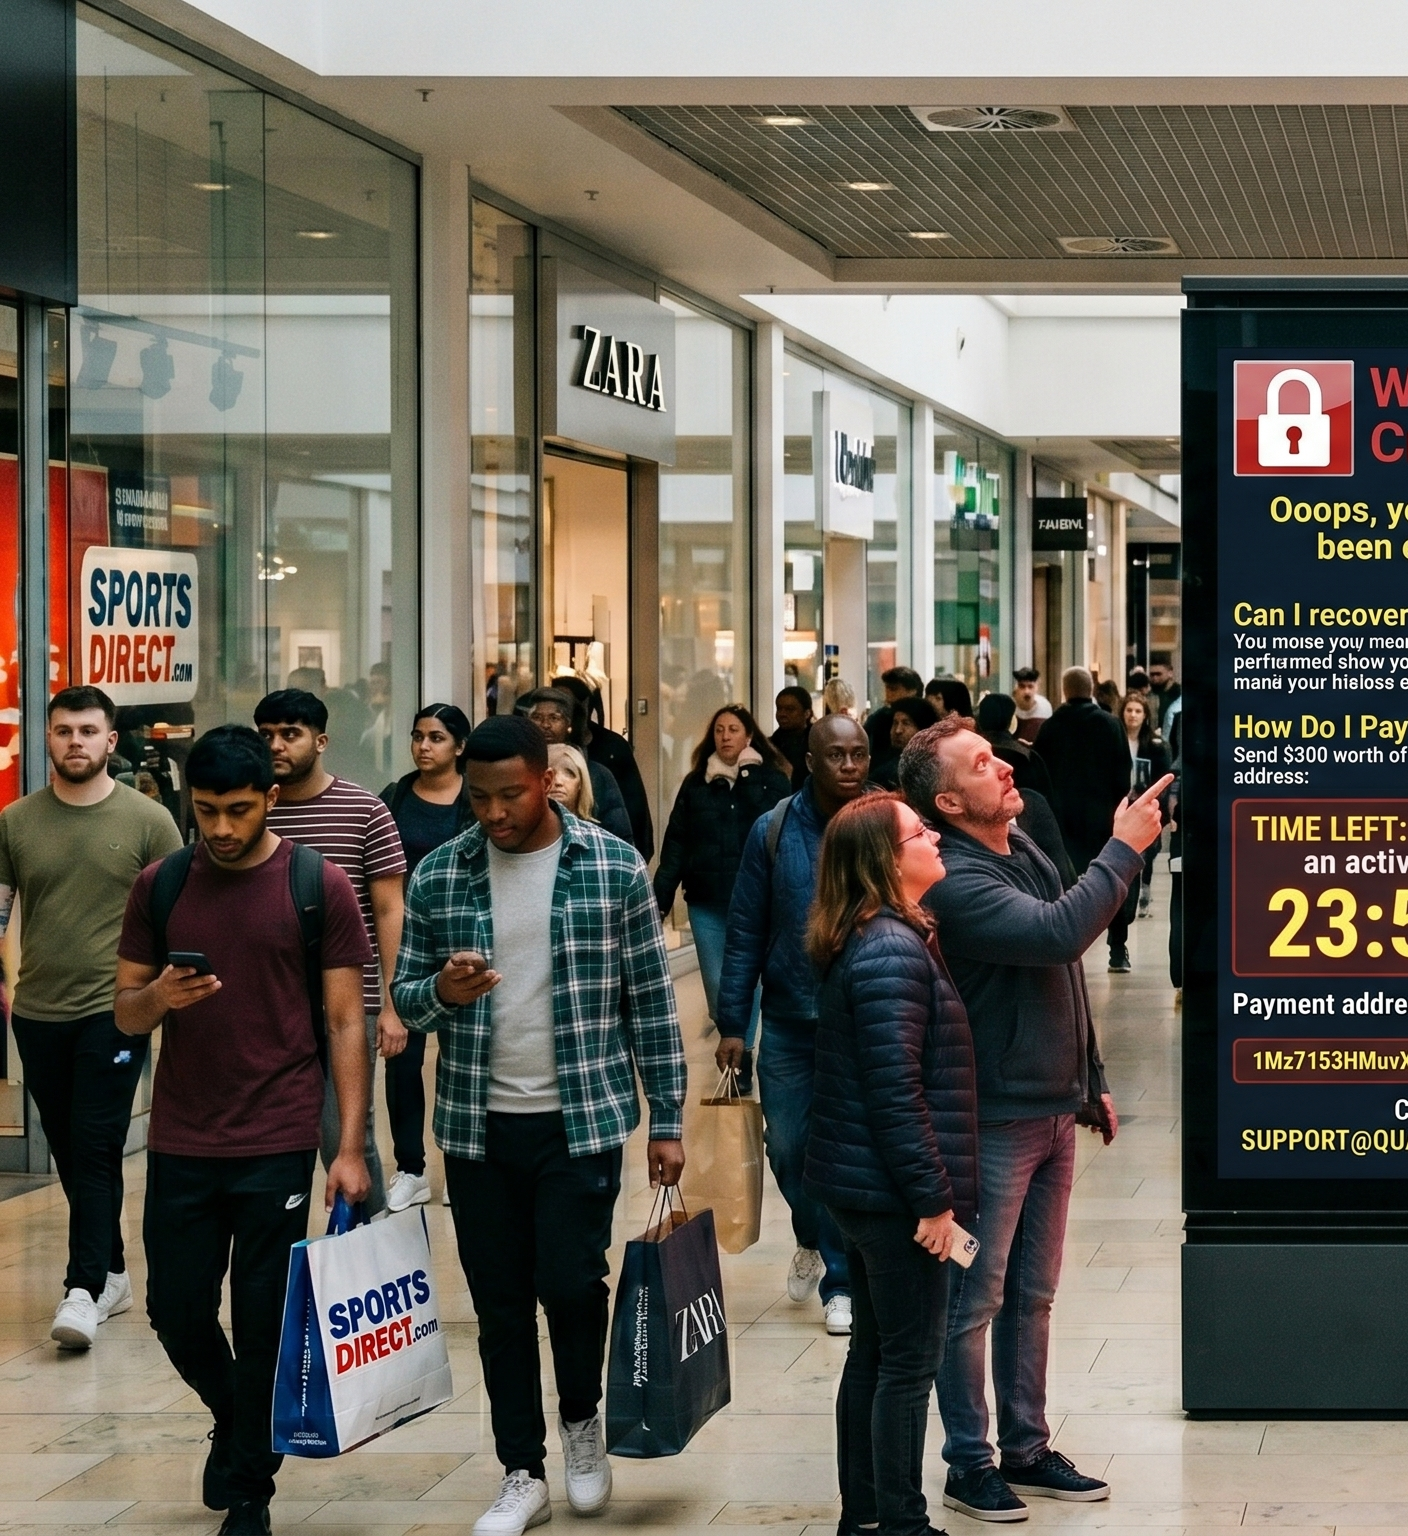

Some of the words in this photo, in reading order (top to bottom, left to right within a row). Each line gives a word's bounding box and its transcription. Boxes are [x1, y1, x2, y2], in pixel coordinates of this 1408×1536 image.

[582, 325, 667, 412] ZARA
[1270, 495, 1377, 530] Ooops,
[1317, 531, 1392, 560] been
[88, 567, 192, 629] SPORTS
[1234, 602, 1285, 627] Can
[1293, 602, 1301, 627] I
[1233, 633, 1267, 650] You
[1337, 653, 1386, 670] show
[1287, 677, 1328, 694] your
[1234, 714, 1293, 739] How
[1301, 714, 1336, 739] Do
[1343, 714, 1352, 739] I
[1233, 746, 1278, 764] Send
[1283, 744, 1328, 766] $300
[1332, 745, 1384, 764] worth
[1388, 745, 1408, 764] of
[1233, 767, 1309, 785] address:
[1250, 815, 1322, 842] TIME
[1330, 815, 1407, 842] LEFT:
[1304, 854, 1336, 874] an
[1233, 992, 1335, 1021] Payment
[328, 1269, 430, 1339] SPORTS
